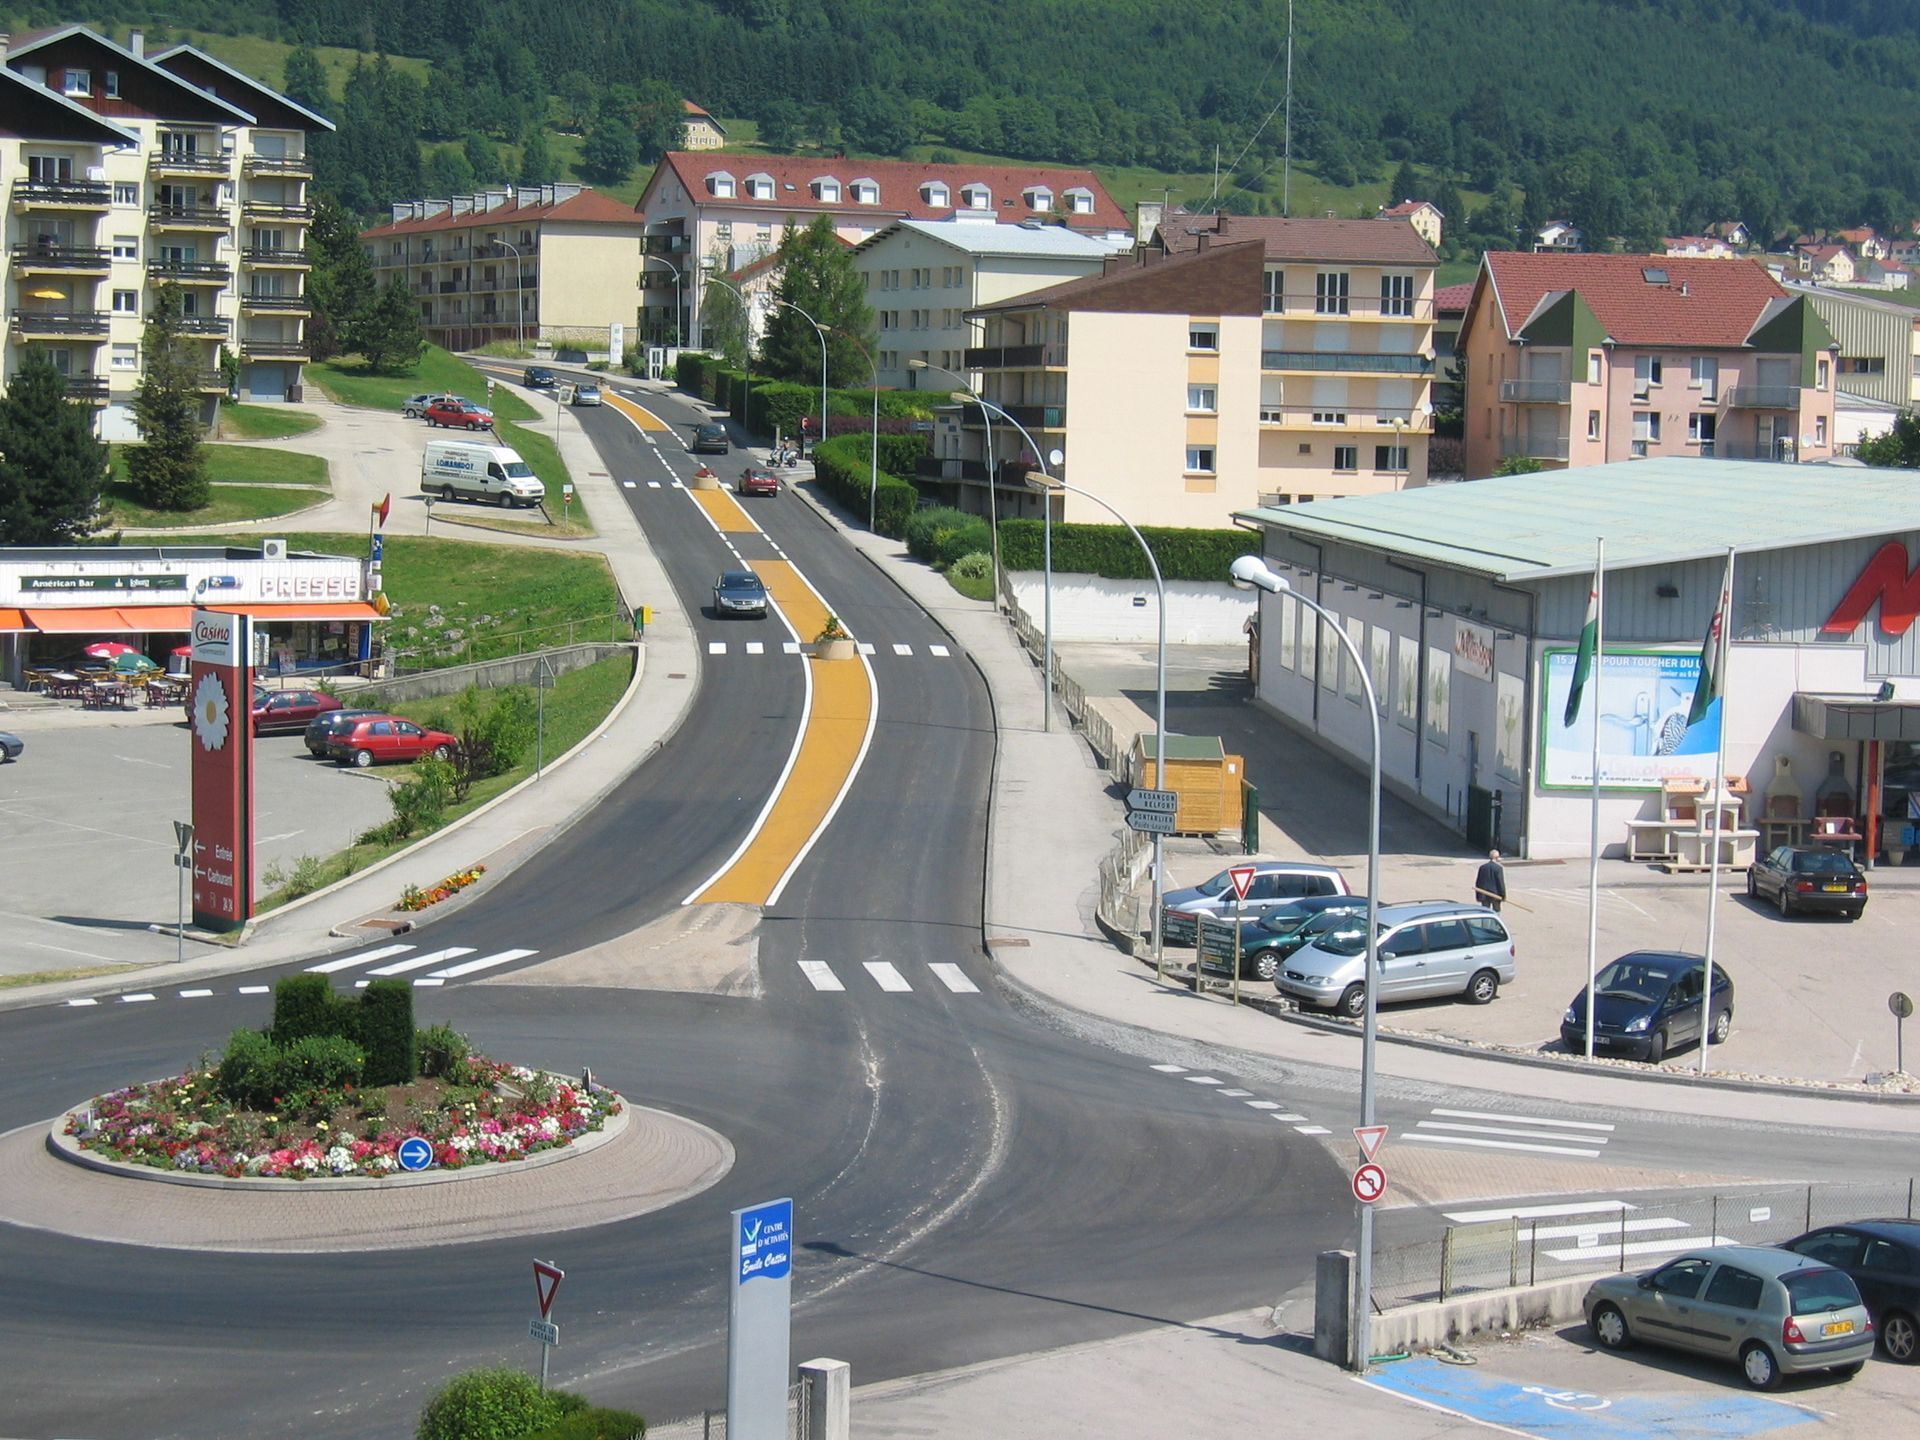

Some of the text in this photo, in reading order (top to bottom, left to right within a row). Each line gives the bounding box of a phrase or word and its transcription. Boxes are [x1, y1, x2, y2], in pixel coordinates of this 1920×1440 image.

[78, 578, 95, 588] Bar
[260, 577, 359, 597] PRESSE
[195, 620, 230, 642] Casino
[1603, 656, 1630, 667] POUR
[1632, 657, 1678, 668] TOUCHER
[1679, 658, 1695, 668] DU
[1145, 801, 1175, 809] BELFORT
